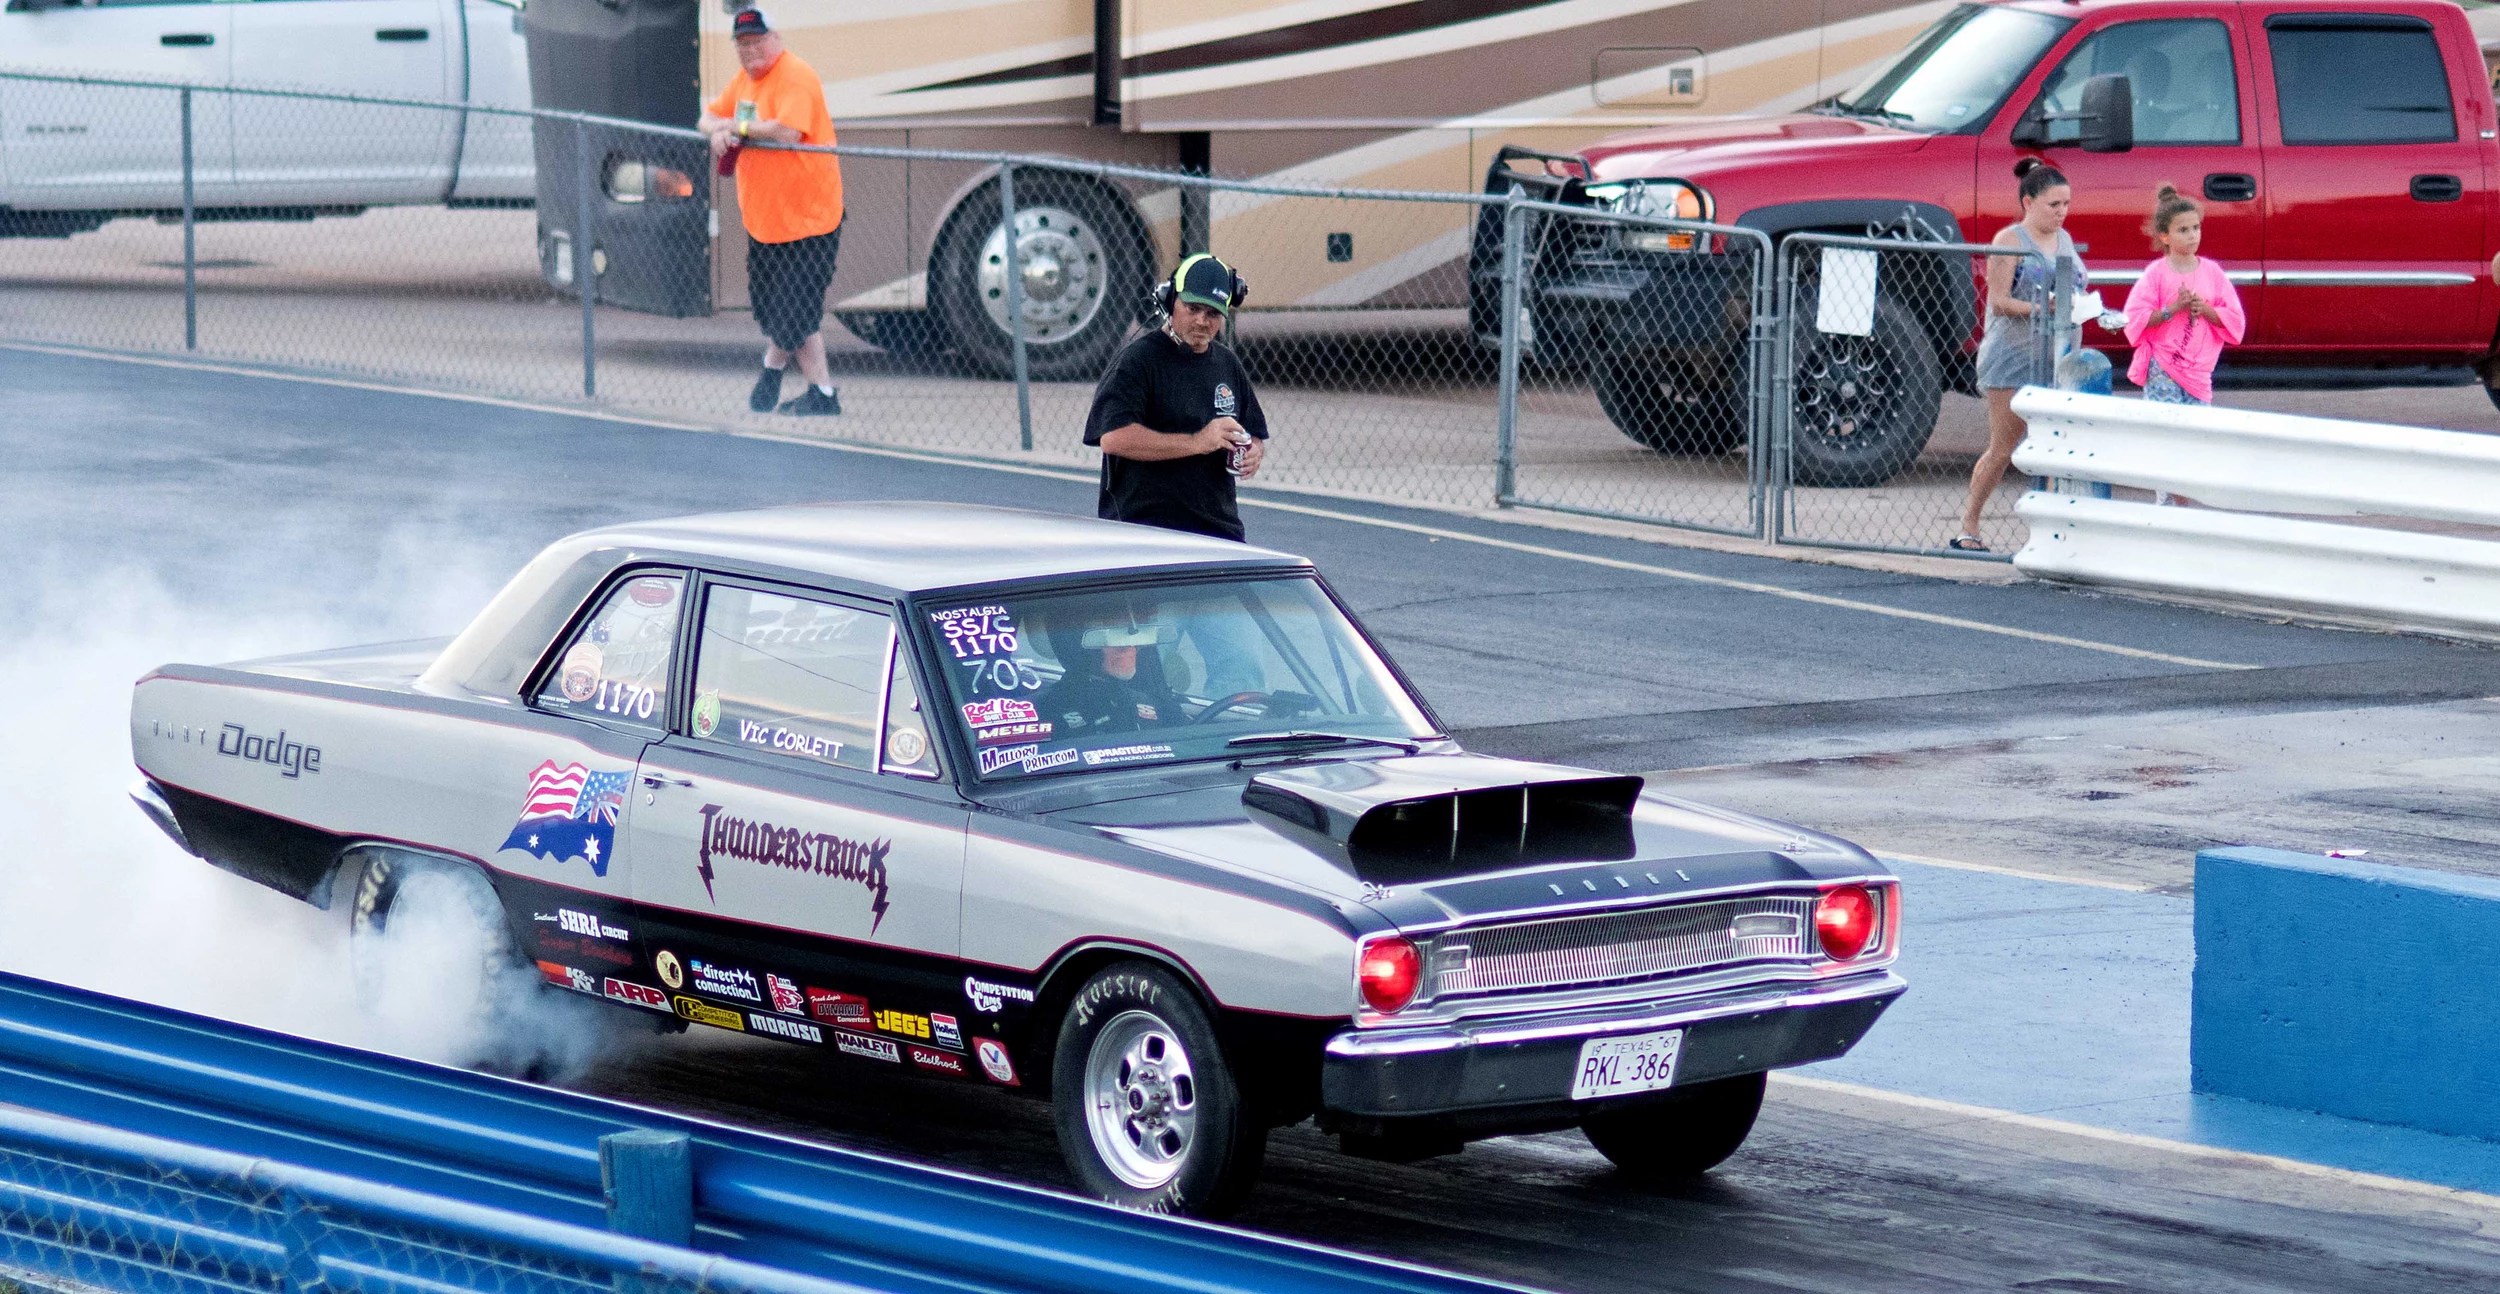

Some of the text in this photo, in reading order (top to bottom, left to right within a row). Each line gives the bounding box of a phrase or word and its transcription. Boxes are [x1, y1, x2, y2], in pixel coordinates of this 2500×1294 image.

[931, 606, 1007, 622] NOSTALGIA
[943, 615, 1016, 639] SS/C
[950, 632, 1018, 658] 1170
[595, 680, 655, 718] 1170
[963, 700, 994, 721] Red
[978, 723, 1052, 739] MEYER
[218, 722, 321, 780] Dodge
[697, 803, 891, 938] THUNDERSTRUCK
[559, 908, 601, 938] SHRA
[601, 925, 629, 941] CIRCUIT
[703, 964, 735, 983] direct
[605, 979, 666, 1005] ARP
[695, 978, 752, 999] connection
[965, 976, 1034, 1002] COMPETITION
[696, 1005, 739, 1020] COMPETITION
[817, 1004, 864, 1017] DYNAMIC
[837, 1016, 871, 1025] Converters
[749, 1013, 823, 1043] MOROSO
[877, 1009, 930, 1039] JEG'S
[934, 1022, 958, 1039] Holley
[838, 1033, 889, 1055] MANLEY
[1592, 1036, 1677, 1056] 19 TEXAS 67
